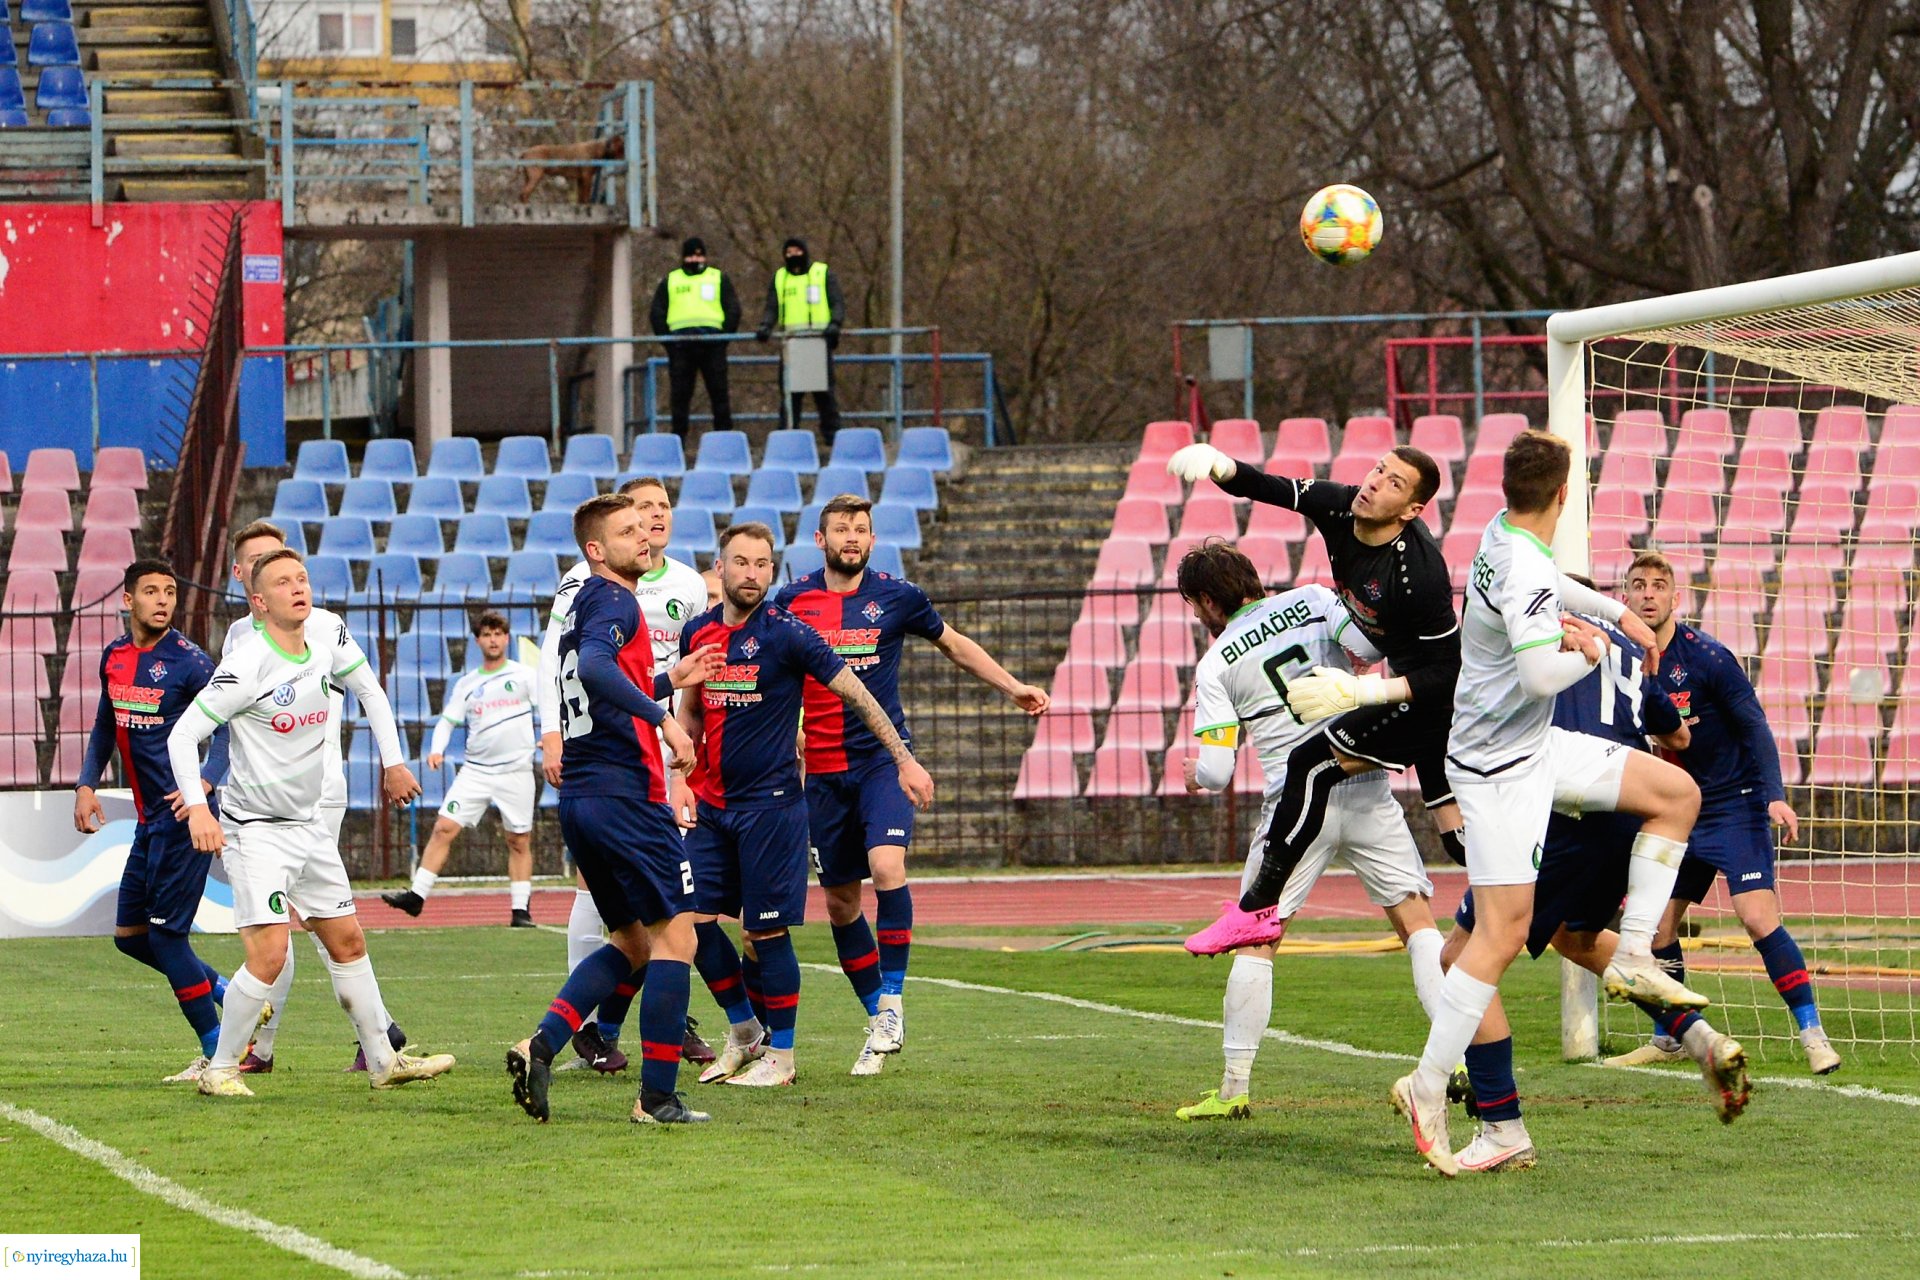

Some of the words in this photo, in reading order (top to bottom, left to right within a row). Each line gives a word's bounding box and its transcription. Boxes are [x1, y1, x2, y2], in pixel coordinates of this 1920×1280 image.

[818, 628, 881, 648] EVESZ
[1220, 599, 1312, 666] BUDAÖRS
[709, 665, 760, 681] VESZ
[558, 649, 593, 741] 8
[298, 710, 328, 727] VEO
[1336, 728, 1356, 747] JAKO
[886, 828, 906, 837] JAKO
[1741, 871, 1762, 882] JAKO
[759, 910, 780, 920] JAKO
